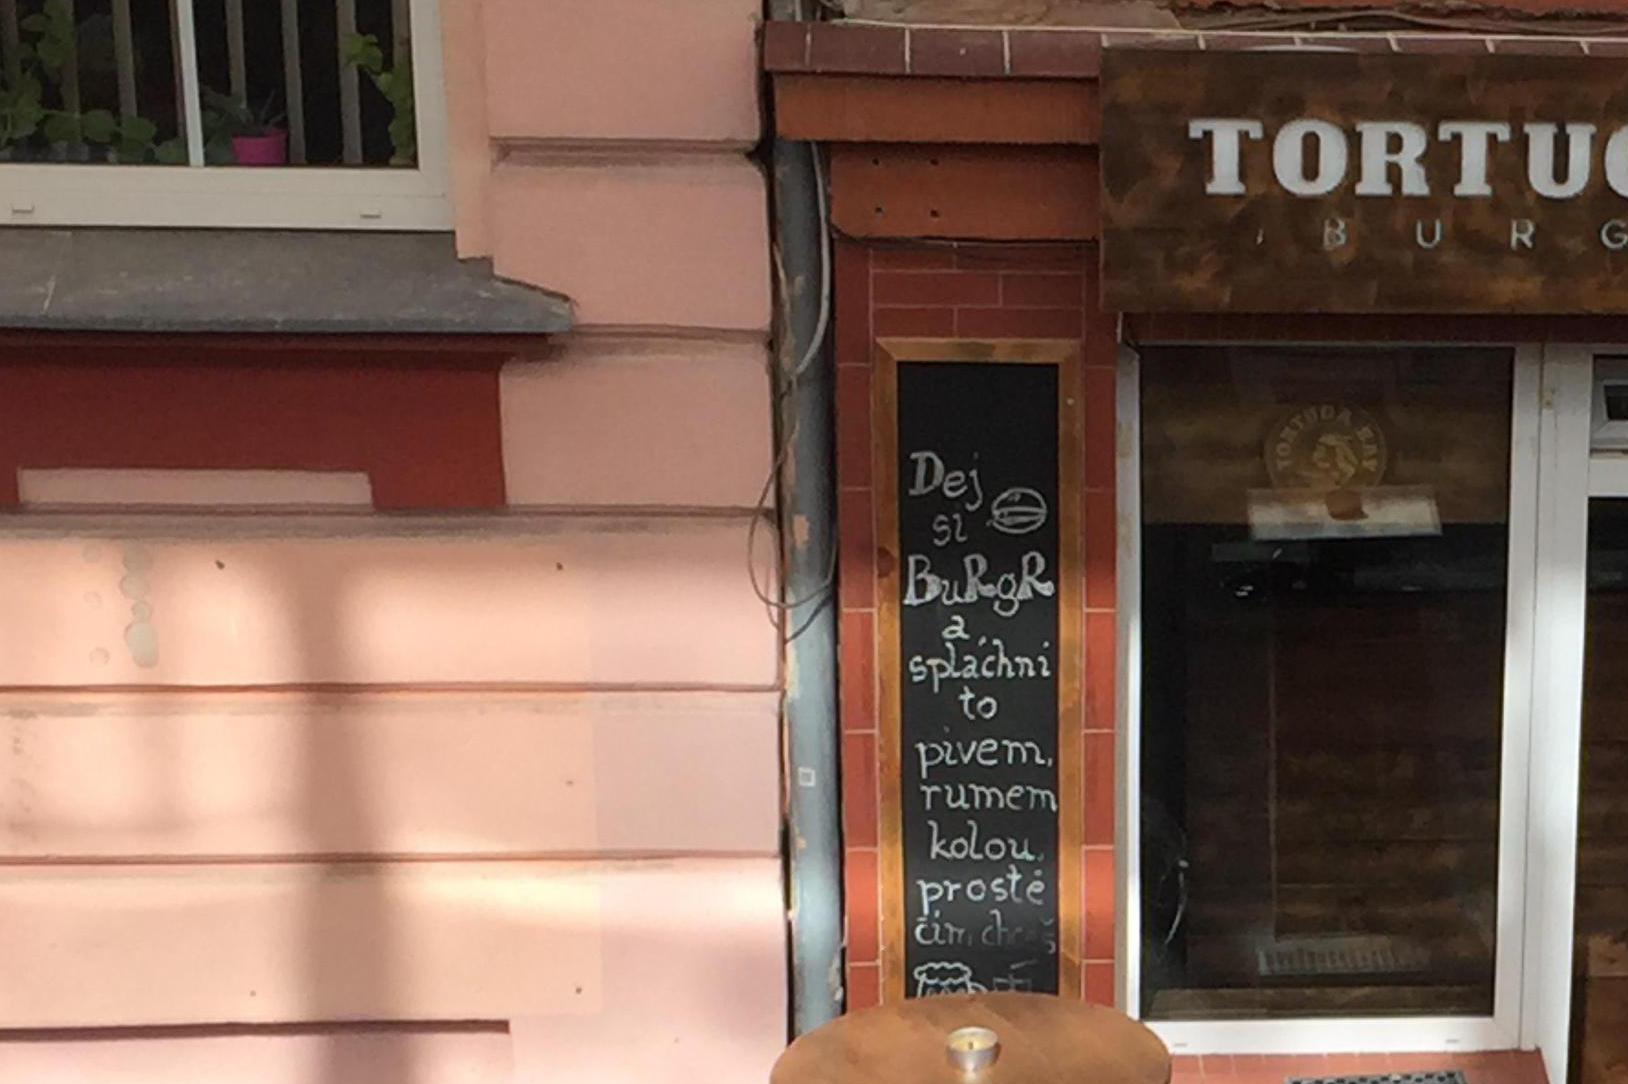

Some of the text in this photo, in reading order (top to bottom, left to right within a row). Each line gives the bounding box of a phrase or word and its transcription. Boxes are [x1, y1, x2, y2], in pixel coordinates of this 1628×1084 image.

[908, 451, 983, 511] Dej
[932, 513, 967, 546] si
[942, 615, 970, 639] a
[908, 635, 1051, 693] spláchni
[958, 685, 998, 720] to
